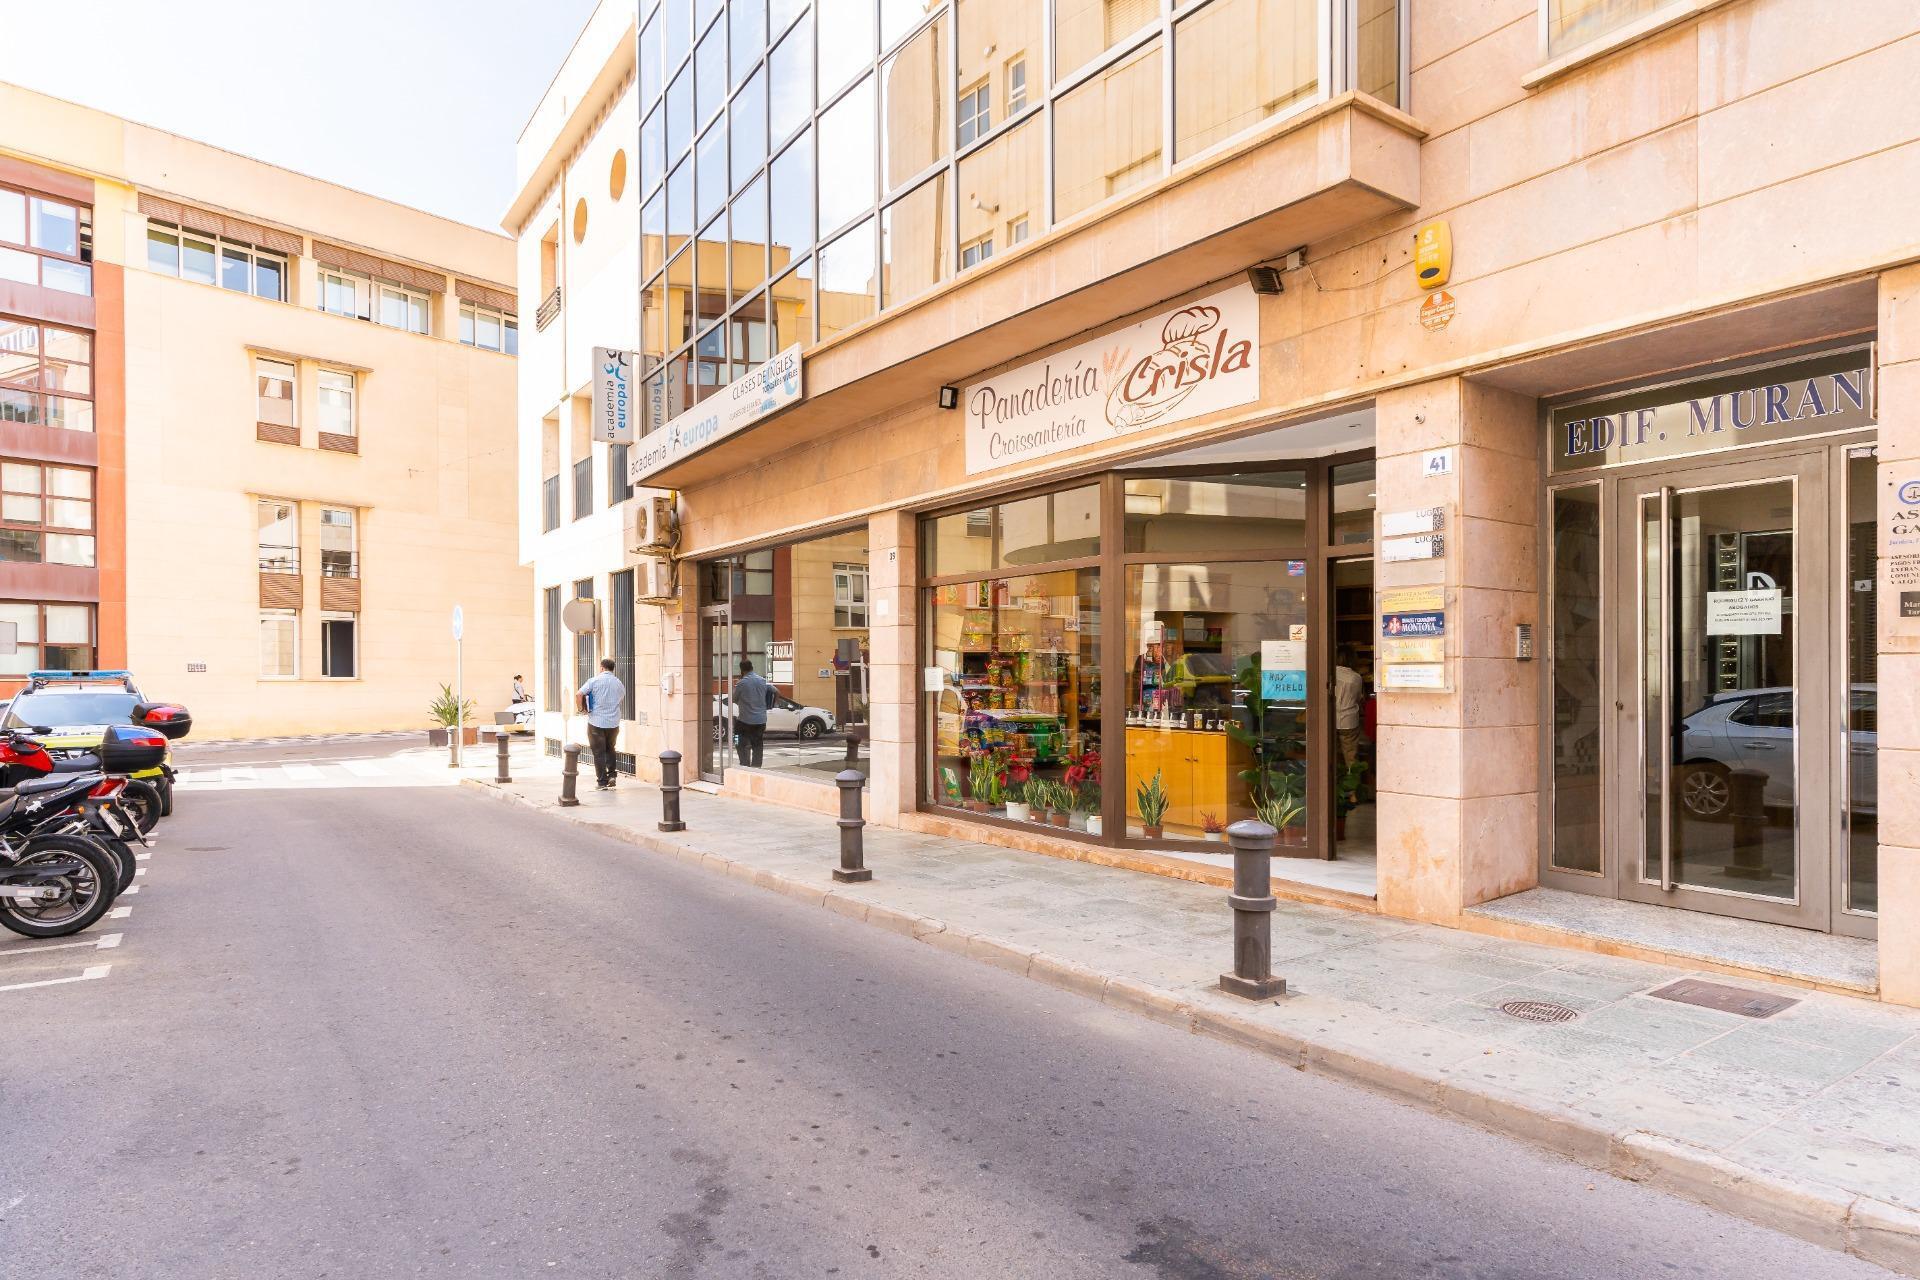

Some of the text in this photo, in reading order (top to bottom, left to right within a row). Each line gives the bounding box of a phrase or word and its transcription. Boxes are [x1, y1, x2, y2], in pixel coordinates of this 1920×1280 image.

[1122, 327, 1252, 403] Crisla
[732, 376, 756, 401] CLASES
[757, 370, 767, 387] DE
[970, 359, 1100, 430] Panadería
[605, 380, 615, 439] academia
[617, 383, 629, 429] europa
[1564, 367, 1873, 458] EDIF. MURAN
[683, 414, 718, 448] europa
[989, 415, 1087, 460] Croissantería
[631, 444, 667, 476] academia
[1429, 454, 1447, 472] 41
[1414, 533, 1444, 544] LUGAR
[1402, 622, 1436, 633] MONTOYA
[766, 643, 793, 659] SE ALQUILA
